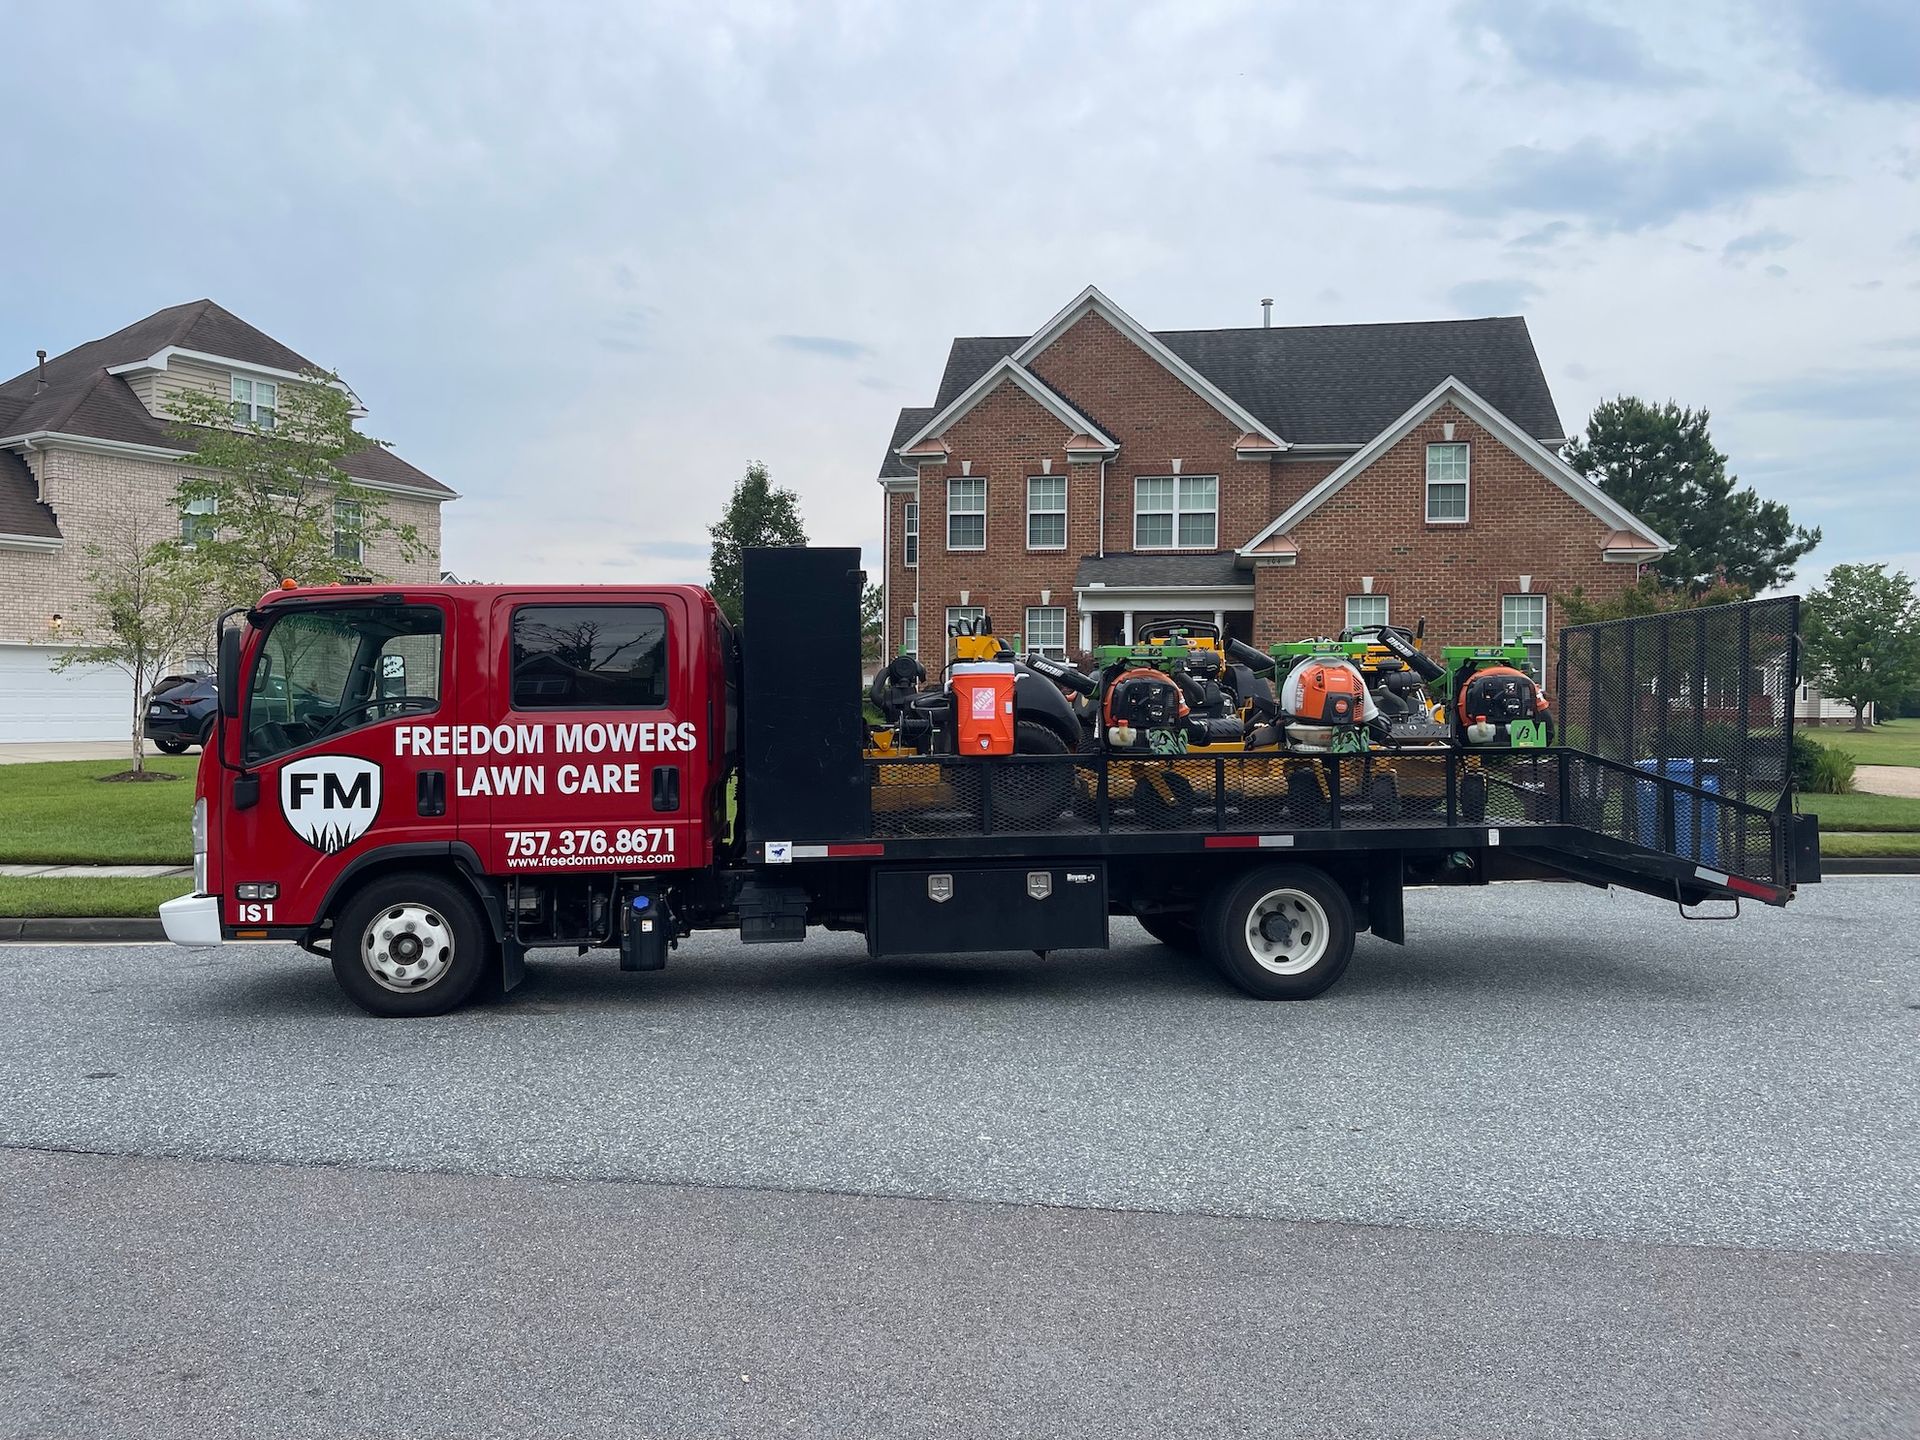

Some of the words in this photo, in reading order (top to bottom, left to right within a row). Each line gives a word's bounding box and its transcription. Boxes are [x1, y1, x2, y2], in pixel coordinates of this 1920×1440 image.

[1386, 636, 1409, 656] ECHO
[1033, 660, 1060, 676] ECHO
[973, 688, 994, 711] HOME
[395, 724, 544, 756] FREEDOM
[556, 722, 697, 753] MOWERS
[290, 772, 371, 810] FM
[457, 765, 545, 797] LAWN
[557, 763, 640, 795] CARE
[505, 828, 675, 856] 757.376.8671
[507, 854, 675, 868] www.freedommowers.com
[239, 904, 274, 922] IS1
